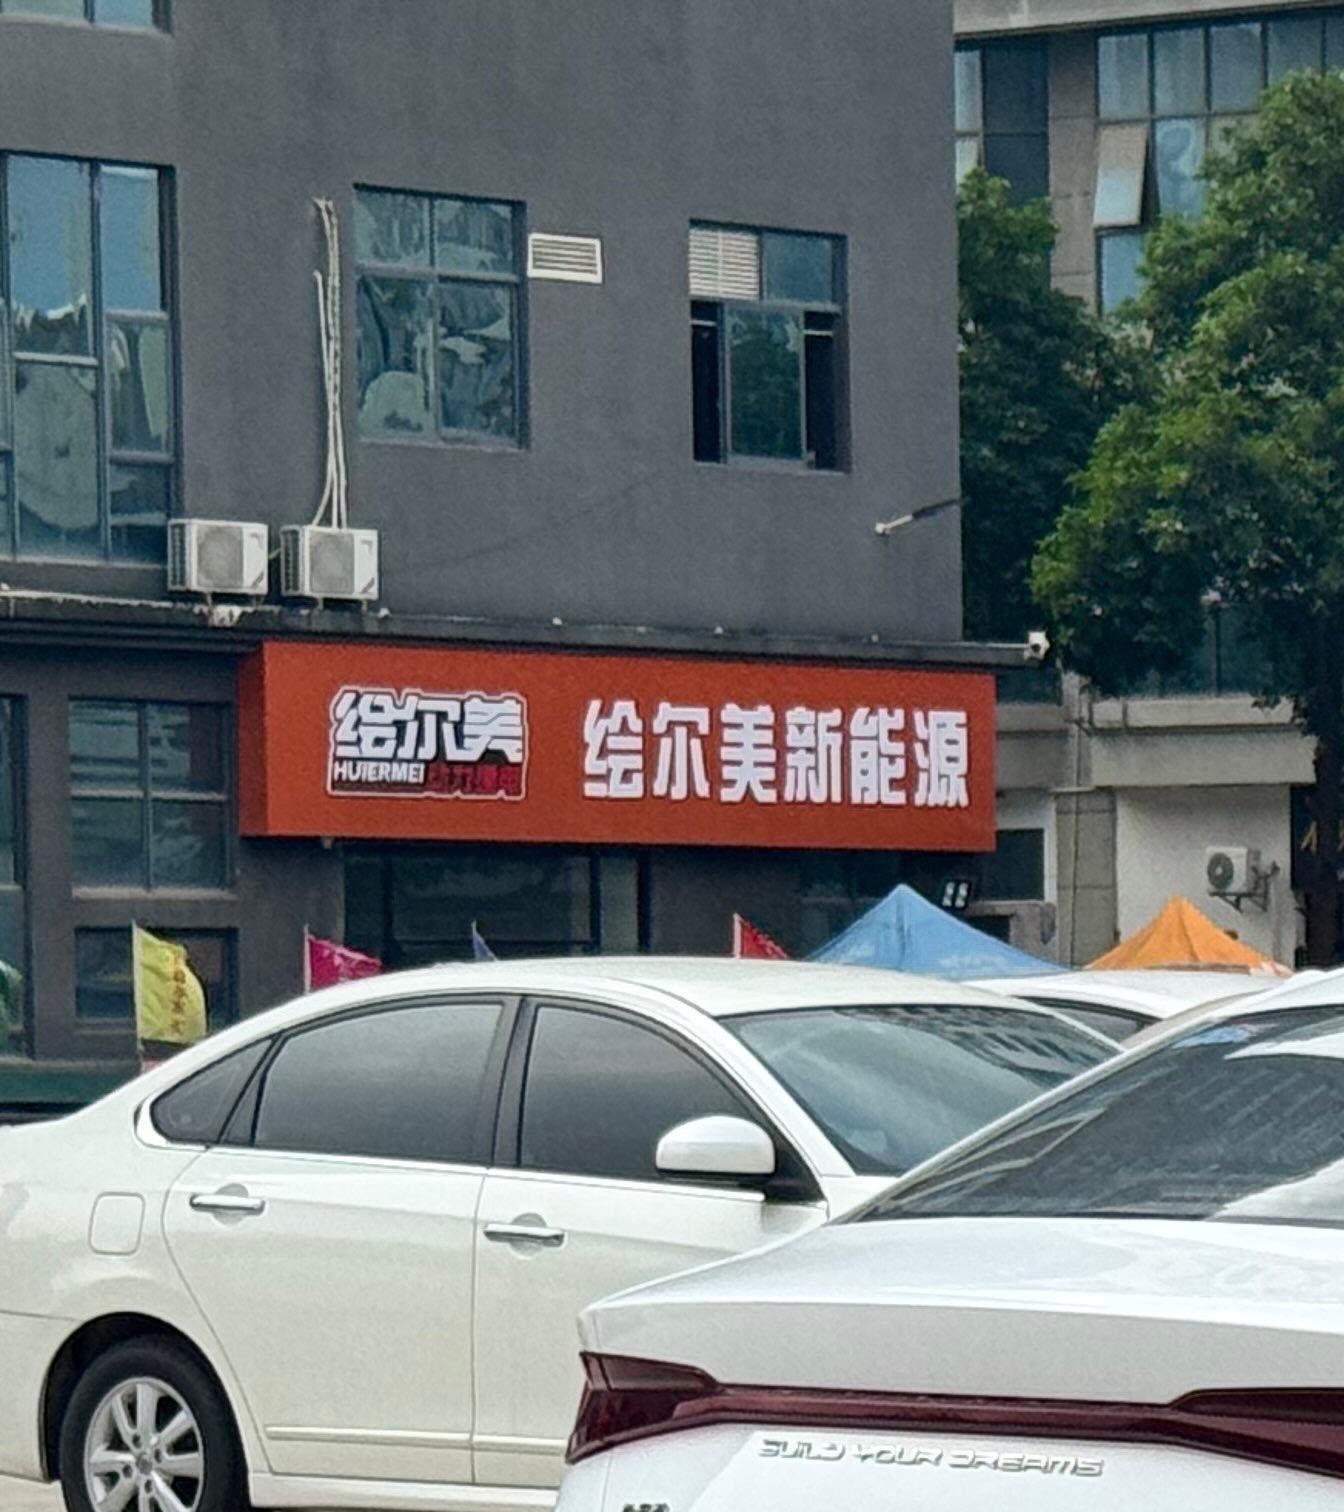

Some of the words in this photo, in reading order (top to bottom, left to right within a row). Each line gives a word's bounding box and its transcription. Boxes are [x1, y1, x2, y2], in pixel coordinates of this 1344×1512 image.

[335, 691, 523, 763] 绘尔美
[583, 699, 969, 808] 绘尔美新能源
[333, 761, 425, 784] HUIERMEI
[758, 1438, 846, 1461] BUILD
[854, 1444, 944, 1467] YOUR
[949, 1450, 1104, 1477] DREAMS
